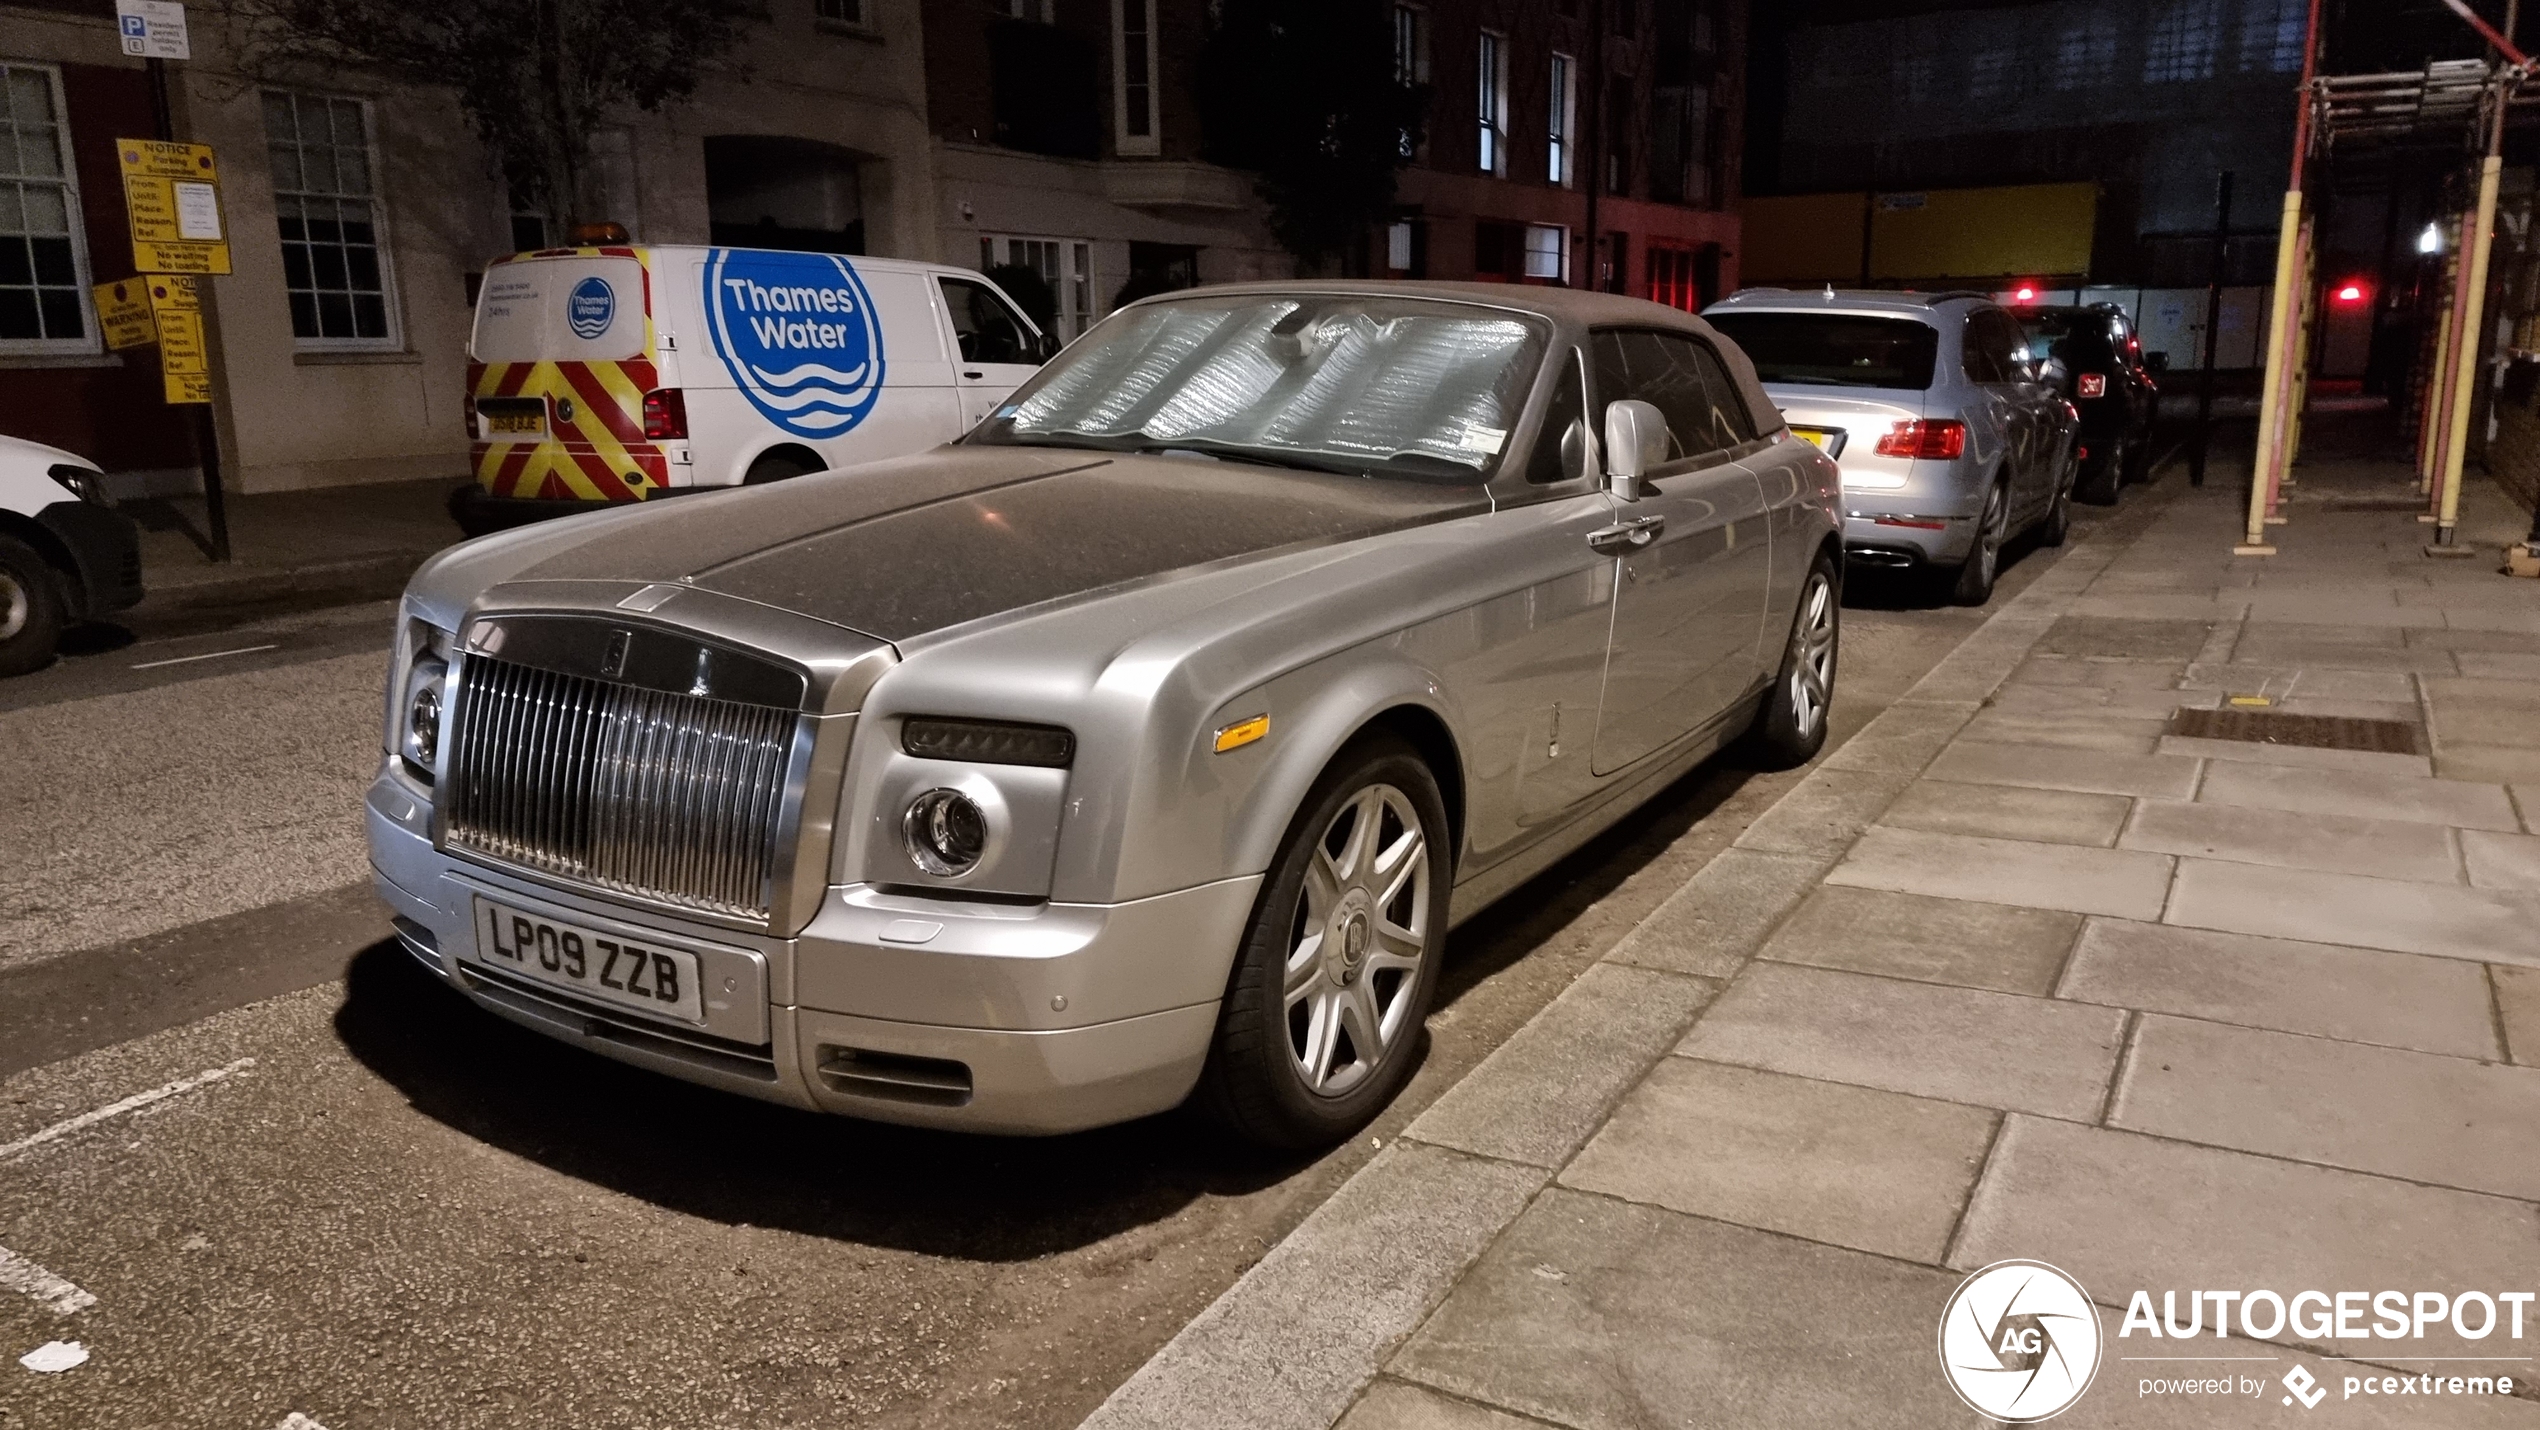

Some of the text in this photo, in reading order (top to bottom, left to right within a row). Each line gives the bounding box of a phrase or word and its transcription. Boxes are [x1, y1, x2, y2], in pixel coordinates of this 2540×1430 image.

[127, 18, 142, 34] P
[133, 41, 140, 49] E
[144, 143, 191, 155] NOTICE
[153, 155, 188, 166] Parking
[146, 165, 197, 175] Suspended
[157, 251, 209, 261] No waiting
[158, 261, 210, 272] No loading
[574, 295, 609, 306] Thames
[723, 278, 854, 313] Thames
[577, 306, 604, 315] Water
[104, 309, 150, 327] WARNING
[750, 316, 847, 350] Water
[489, 908, 680, 1004] LP09 ZZB
